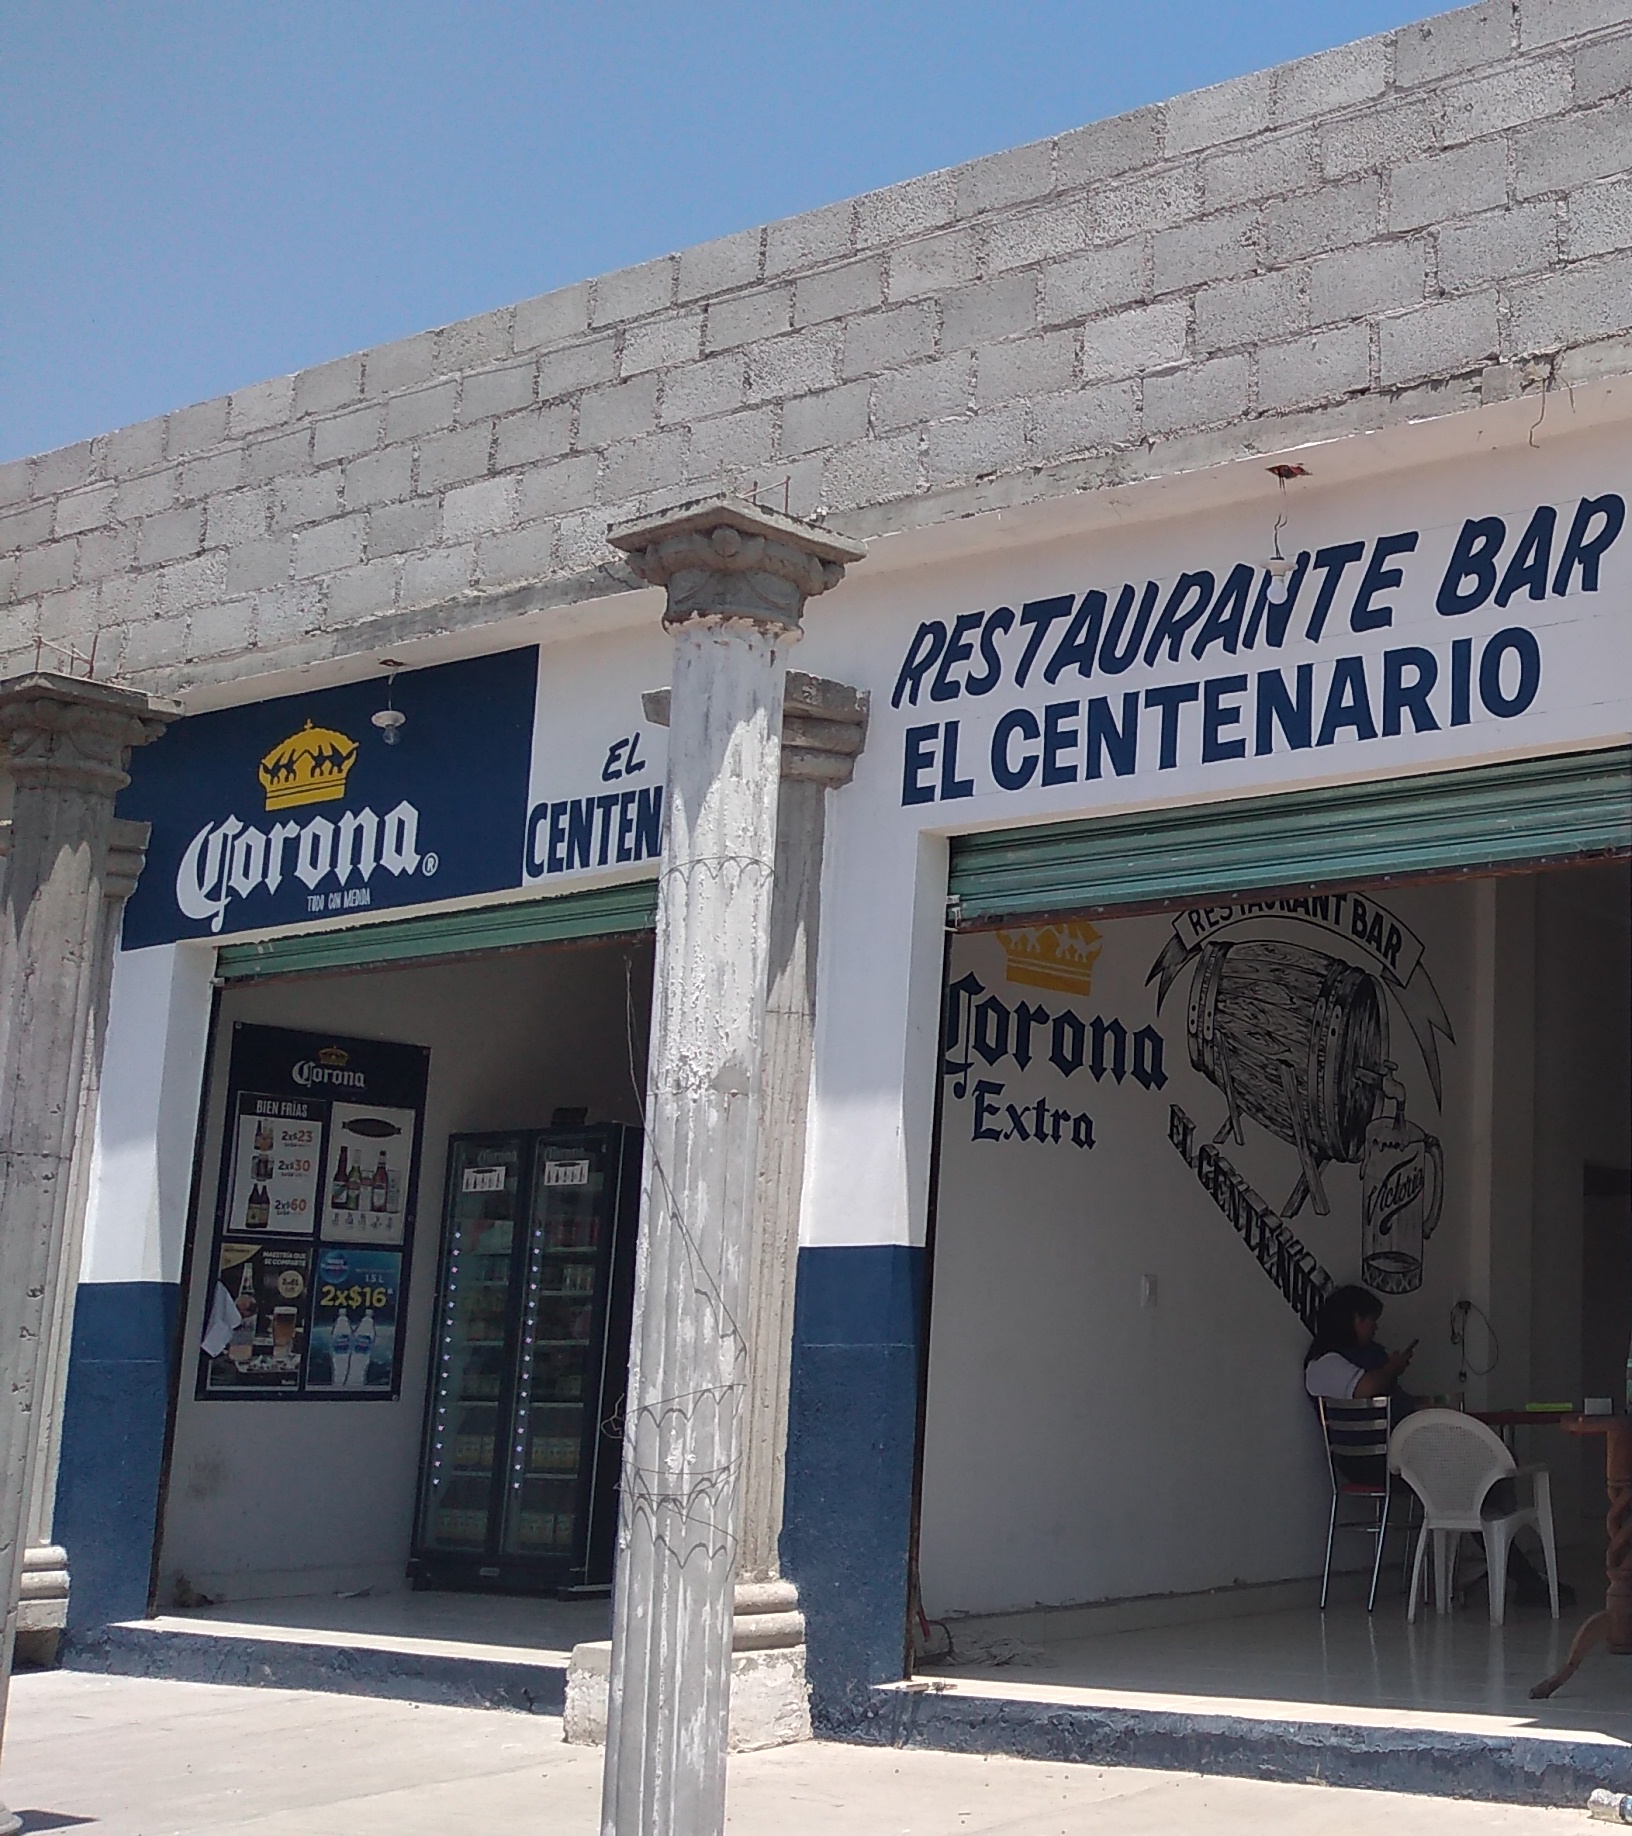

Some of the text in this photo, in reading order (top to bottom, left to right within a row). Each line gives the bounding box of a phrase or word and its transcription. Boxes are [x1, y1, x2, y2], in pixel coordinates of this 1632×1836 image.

[891, 493, 1626, 710] RESTAURANTE BAR
[901, 626, 1541, 808] EL CENTENARIO
[601, 731, 646, 782] EL
[175, 799, 424, 933] Corona
[525, 785, 664, 878] CENTEN
[1352, 898, 1402, 971] BAR
[256, 1099, 279, 1115] BIEN
[291, 1059, 366, 1089] Corona
[971, 1079, 1097, 1150] Extra
[1166, 1103, 1197, 1169] EL
[1367, 1151, 1424, 1226] Victoria
[320, 1284, 387, 1310] 2x$16
